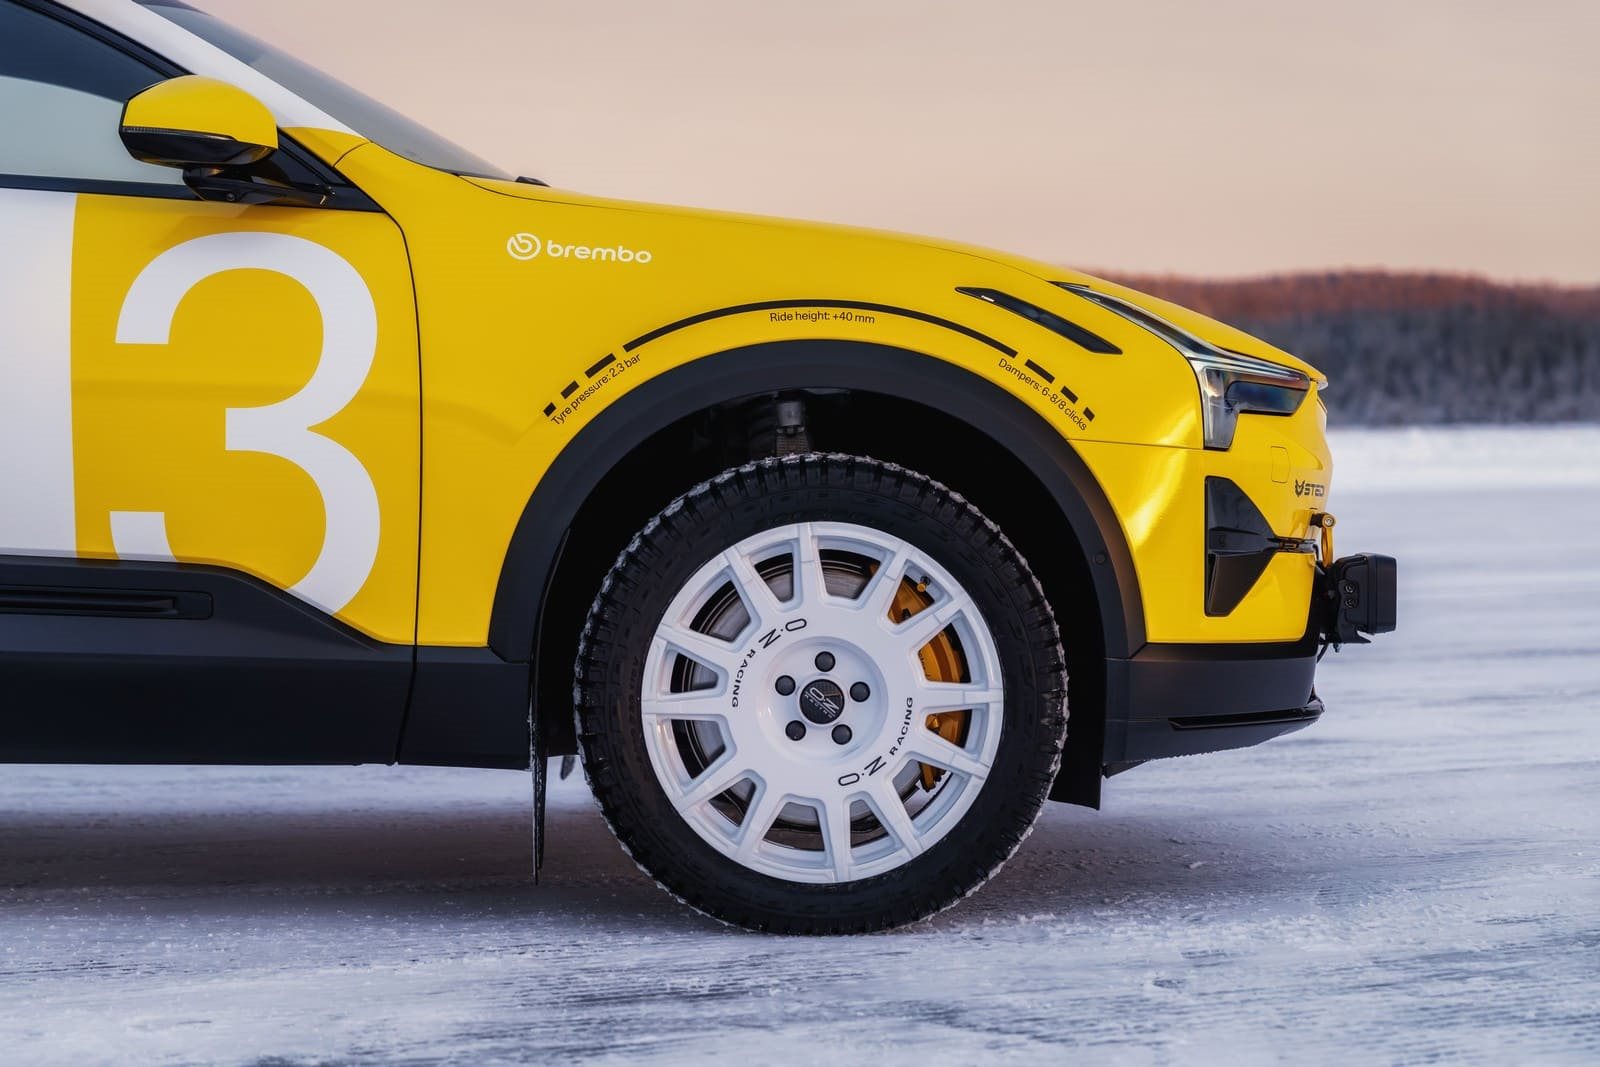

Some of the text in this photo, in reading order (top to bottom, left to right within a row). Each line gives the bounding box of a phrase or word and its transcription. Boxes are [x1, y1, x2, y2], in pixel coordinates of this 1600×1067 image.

[546, 239, 652, 264] brembo
[769, 310, 875, 324] Ride height: +40 mm
[550, 353, 641, 425] Tyre pressure: 2.3 bar
[998, 358, 1087, 431] Dampers: 6-8/8 clicks
[109, 231, 381, 616] 3
[732, 649, 756, 708] RACING
[889, 697, 914, 756] RACING
